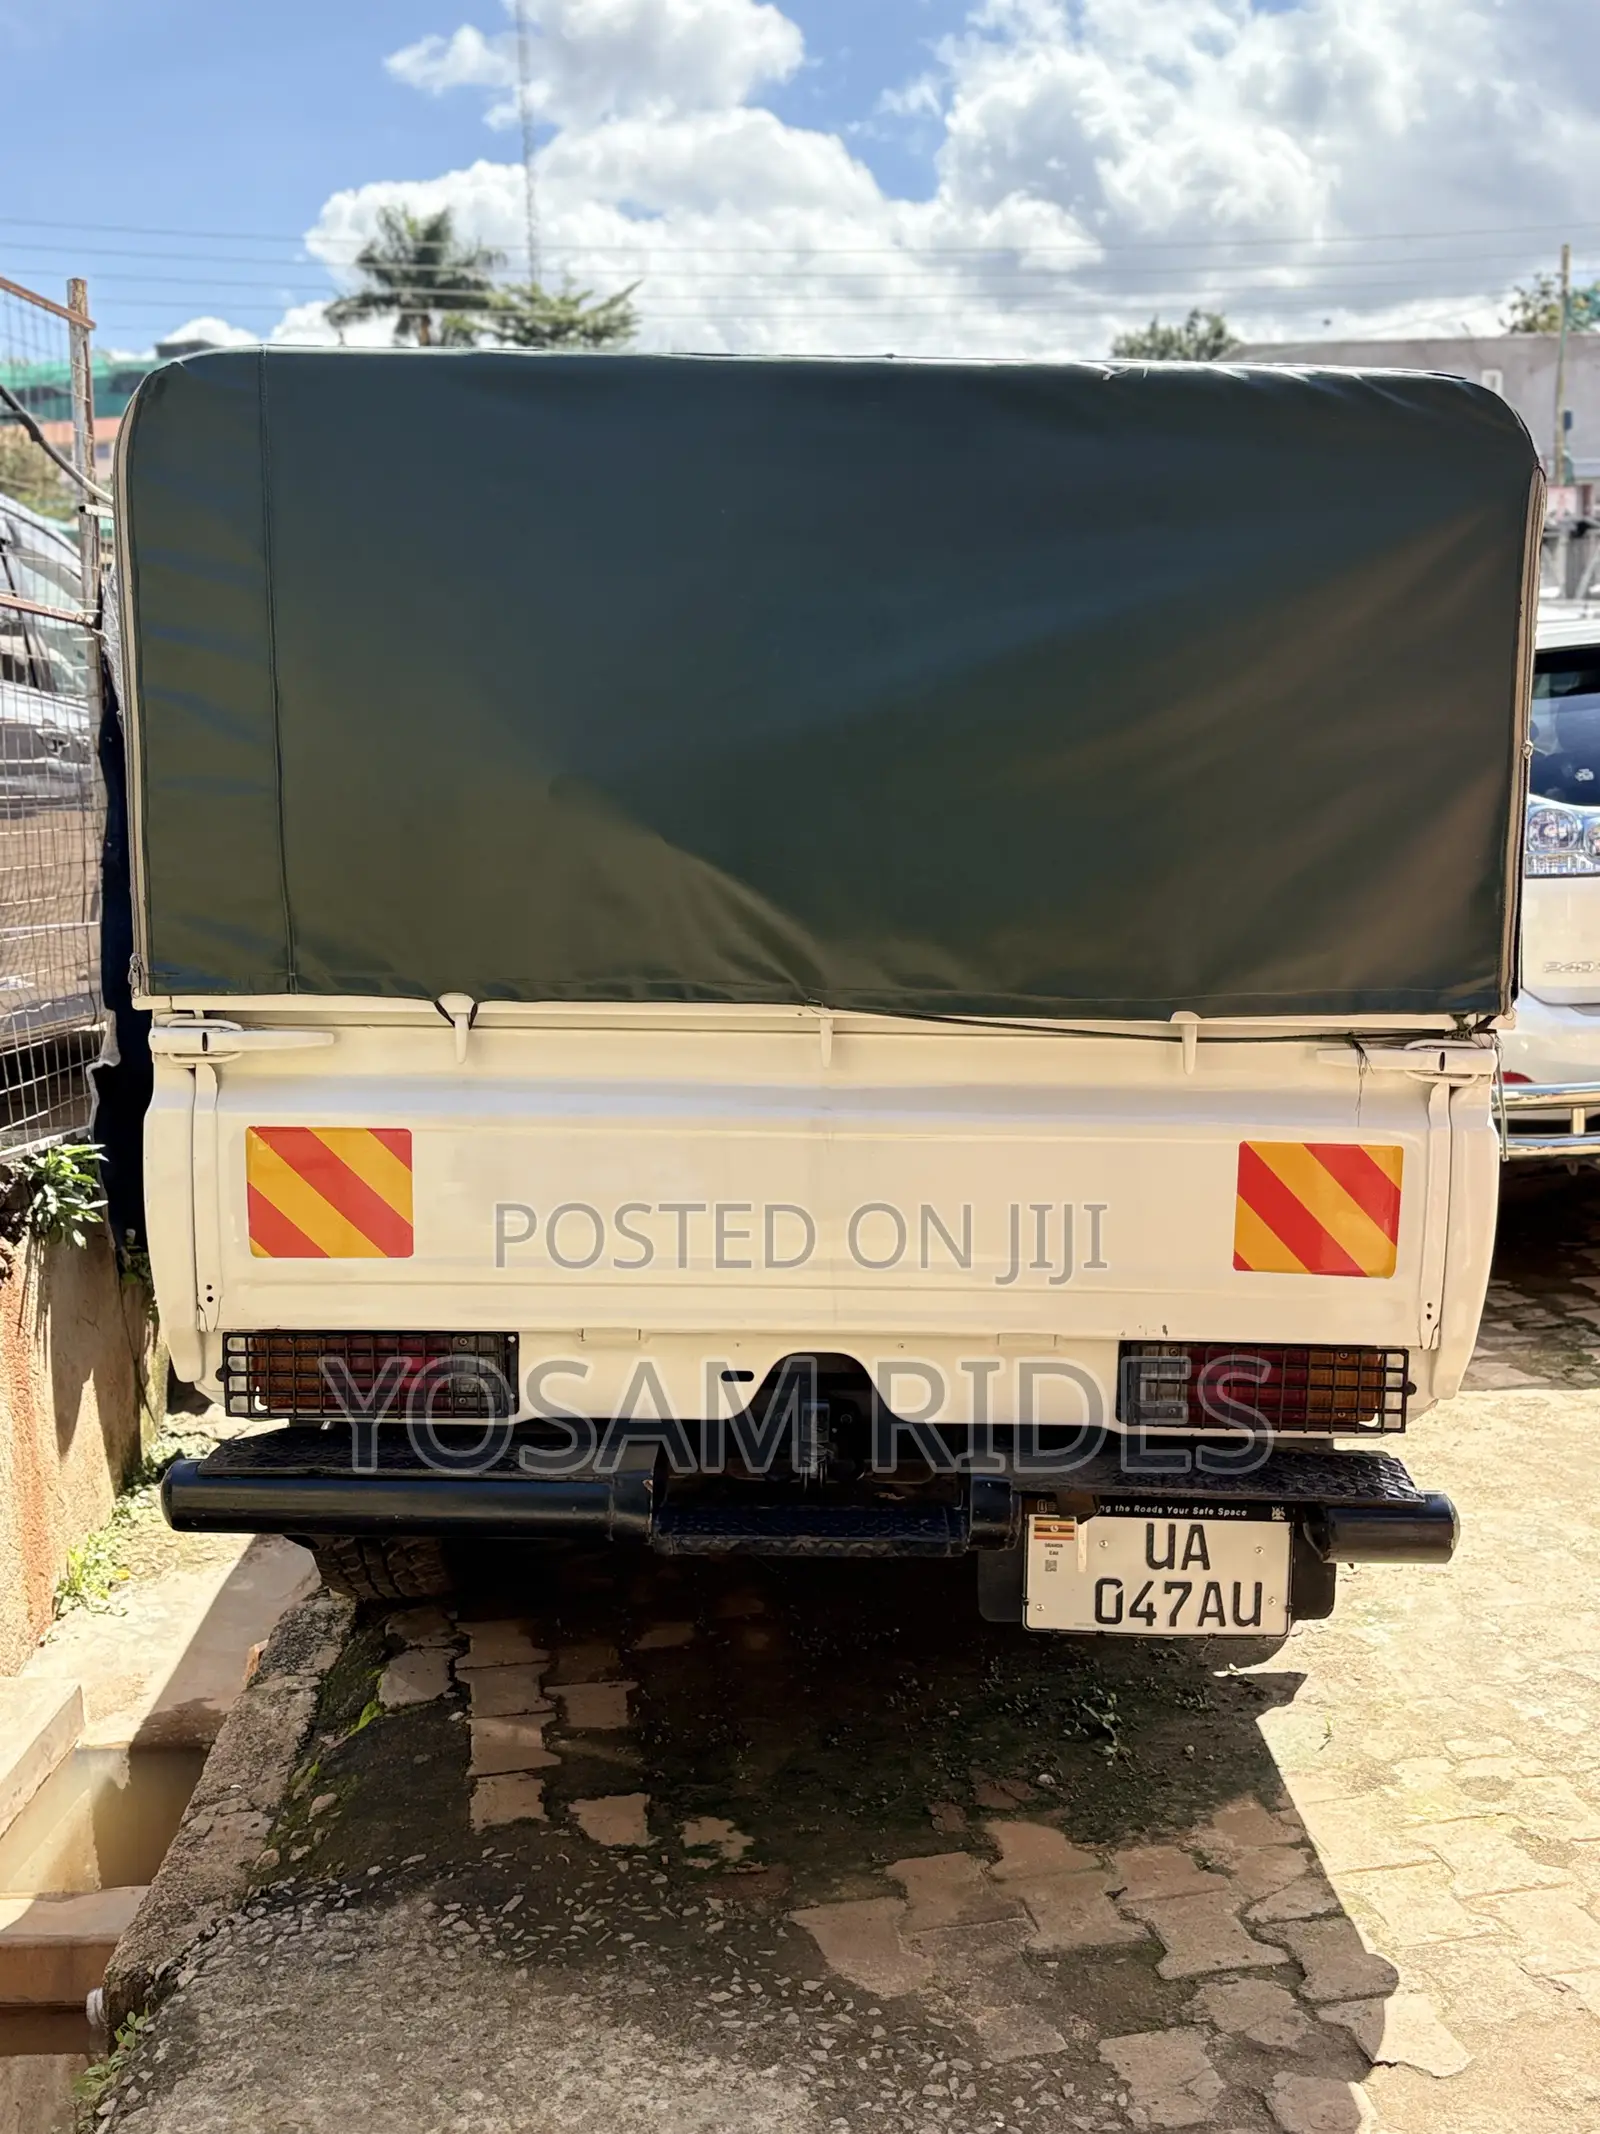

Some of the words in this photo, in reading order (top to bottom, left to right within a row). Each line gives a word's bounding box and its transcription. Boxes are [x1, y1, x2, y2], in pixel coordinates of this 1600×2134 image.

[1134, 1505, 1163, 1514] Roads
[1167, 1506, 1189, 1515] Your
[1193, 1506, 1214, 1516] Safe
[1217, 1508, 1248, 1517] Space
[1146, 1523, 1211, 1571] UA
[1095, 1578, 1263, 1627] 047AU
